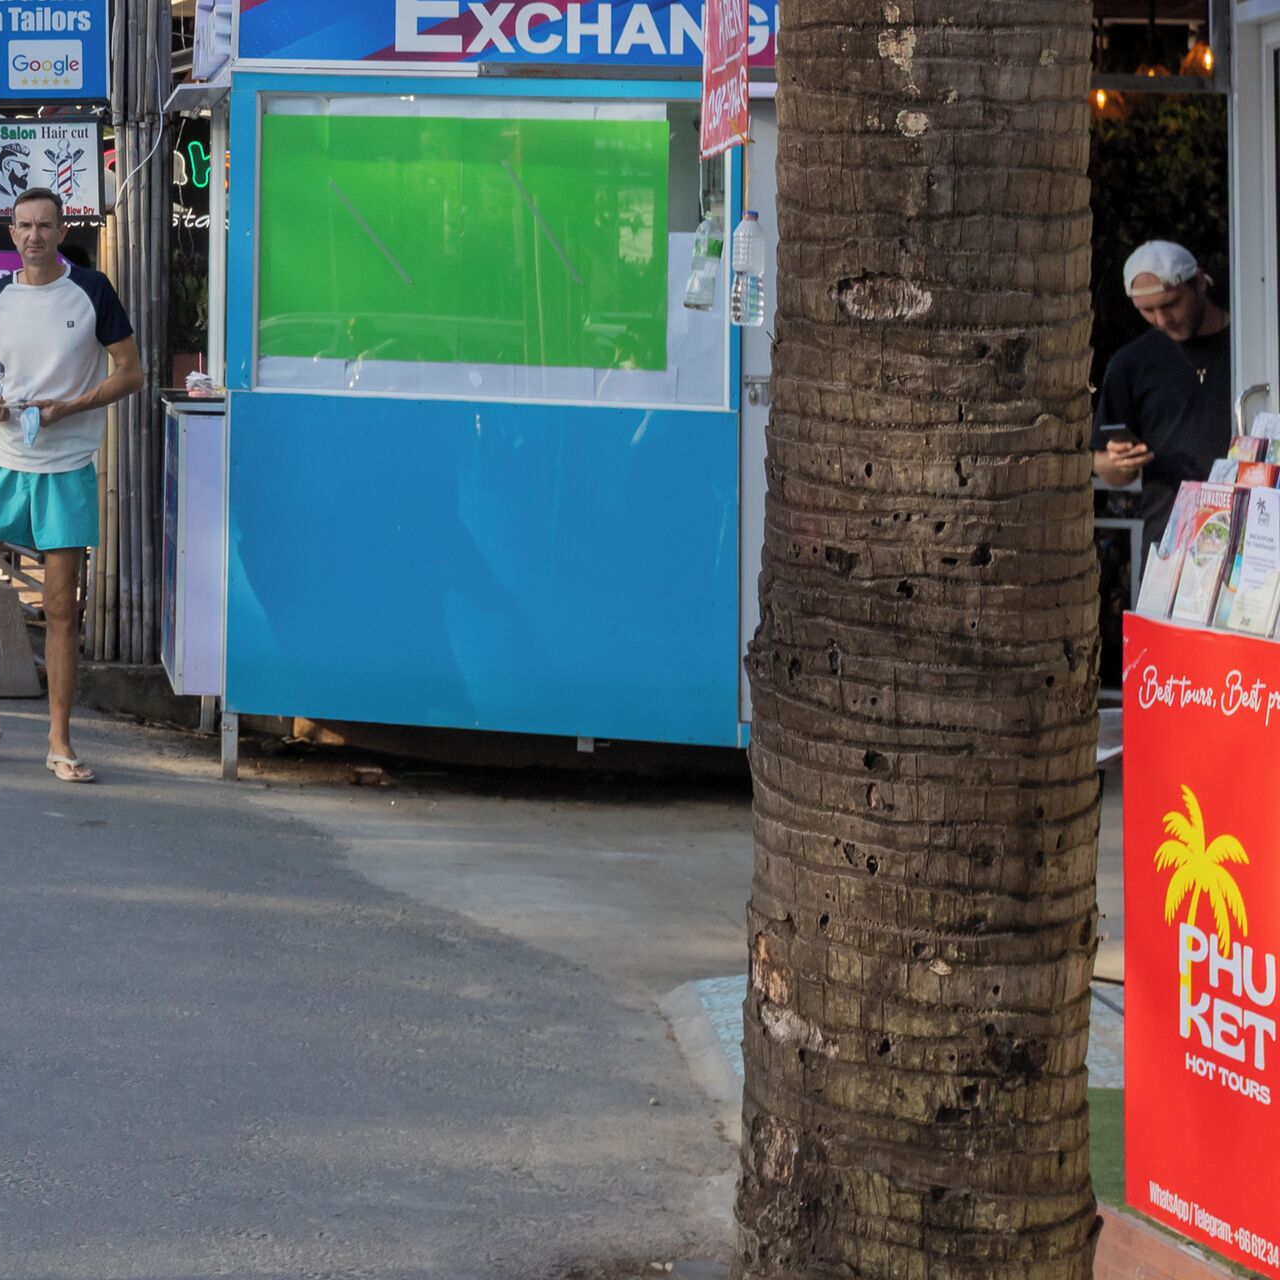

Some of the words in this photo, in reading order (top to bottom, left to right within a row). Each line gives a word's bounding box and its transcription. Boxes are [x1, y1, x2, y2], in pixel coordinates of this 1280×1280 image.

[8, 7, 91, 32] Tailors
[12, 54, 80, 76] Google
[0, 126, 37, 140] Salon
[41, 126, 68, 140] Hair
[71, 127, 89, 139] cut
[65, 206, 82, 216] Blow
[83, 206, 95, 216] Dry
[1139, 665, 1175, 709] Best
[1221, 669, 1267, 716] Best
[1178, 921, 1276, 1007] PHU
[1178, 983, 1276, 1071] KET
[1185, 1052, 1217, 1081] HOT
[1218, 1066, 1271, 1105] TOURS
[1149, 1180, 1189, 1222] WhatsApp
[1193, 1203, 1233, 1245] Telegram:
